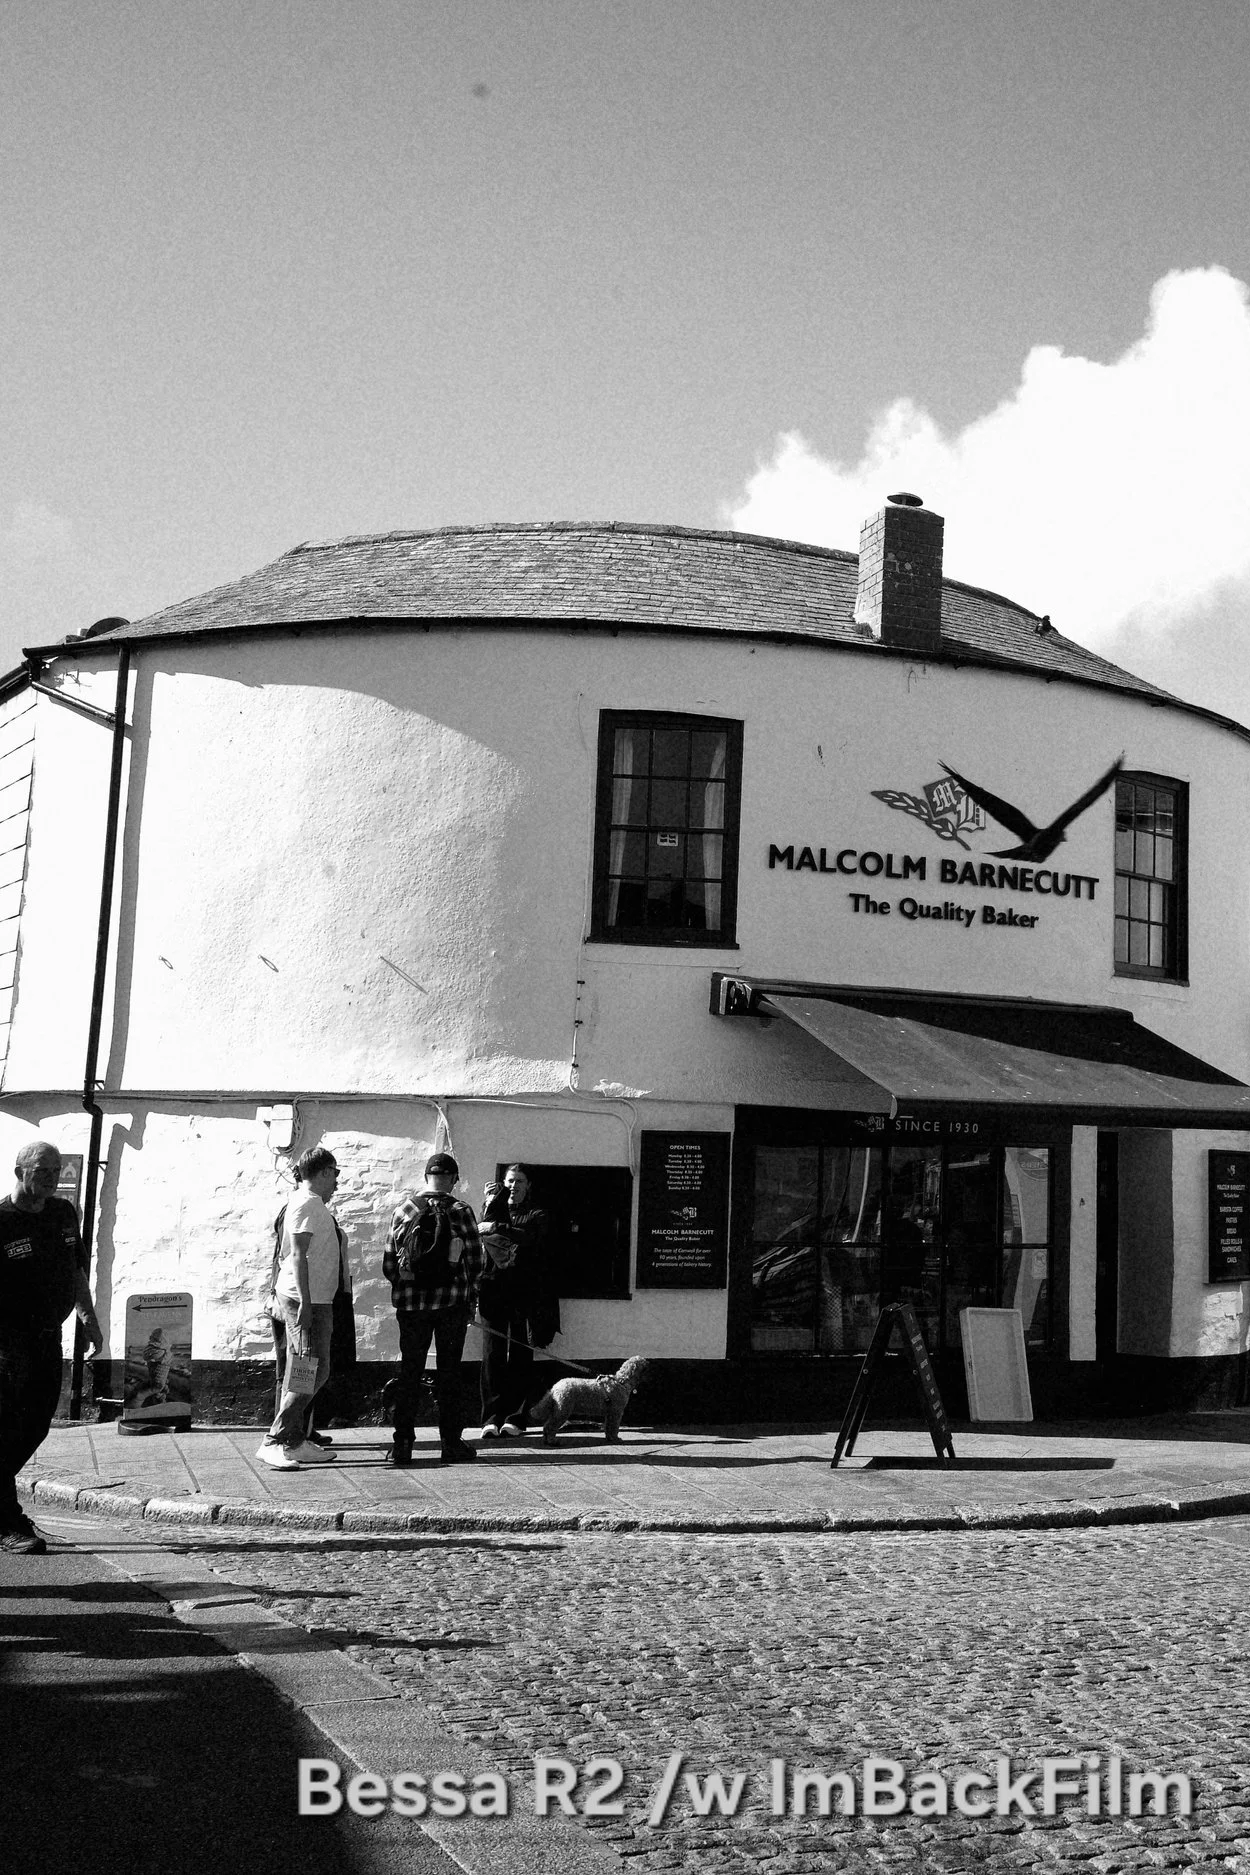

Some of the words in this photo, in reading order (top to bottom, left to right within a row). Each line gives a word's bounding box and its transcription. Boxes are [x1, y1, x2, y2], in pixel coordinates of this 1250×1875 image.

[768, 844, 926, 880] MALCOLM
[941, 859, 1099, 900] BARNECUTT
[849, 893, 890, 915] The
[899, 898, 976, 928] Quality
[982, 906, 1039, 929] Baker
[895, 1119, 940, 1132] SINCE
[949, 1122, 979, 1134] 1930
[137, 1295, 183, 1303] Pendragon's
